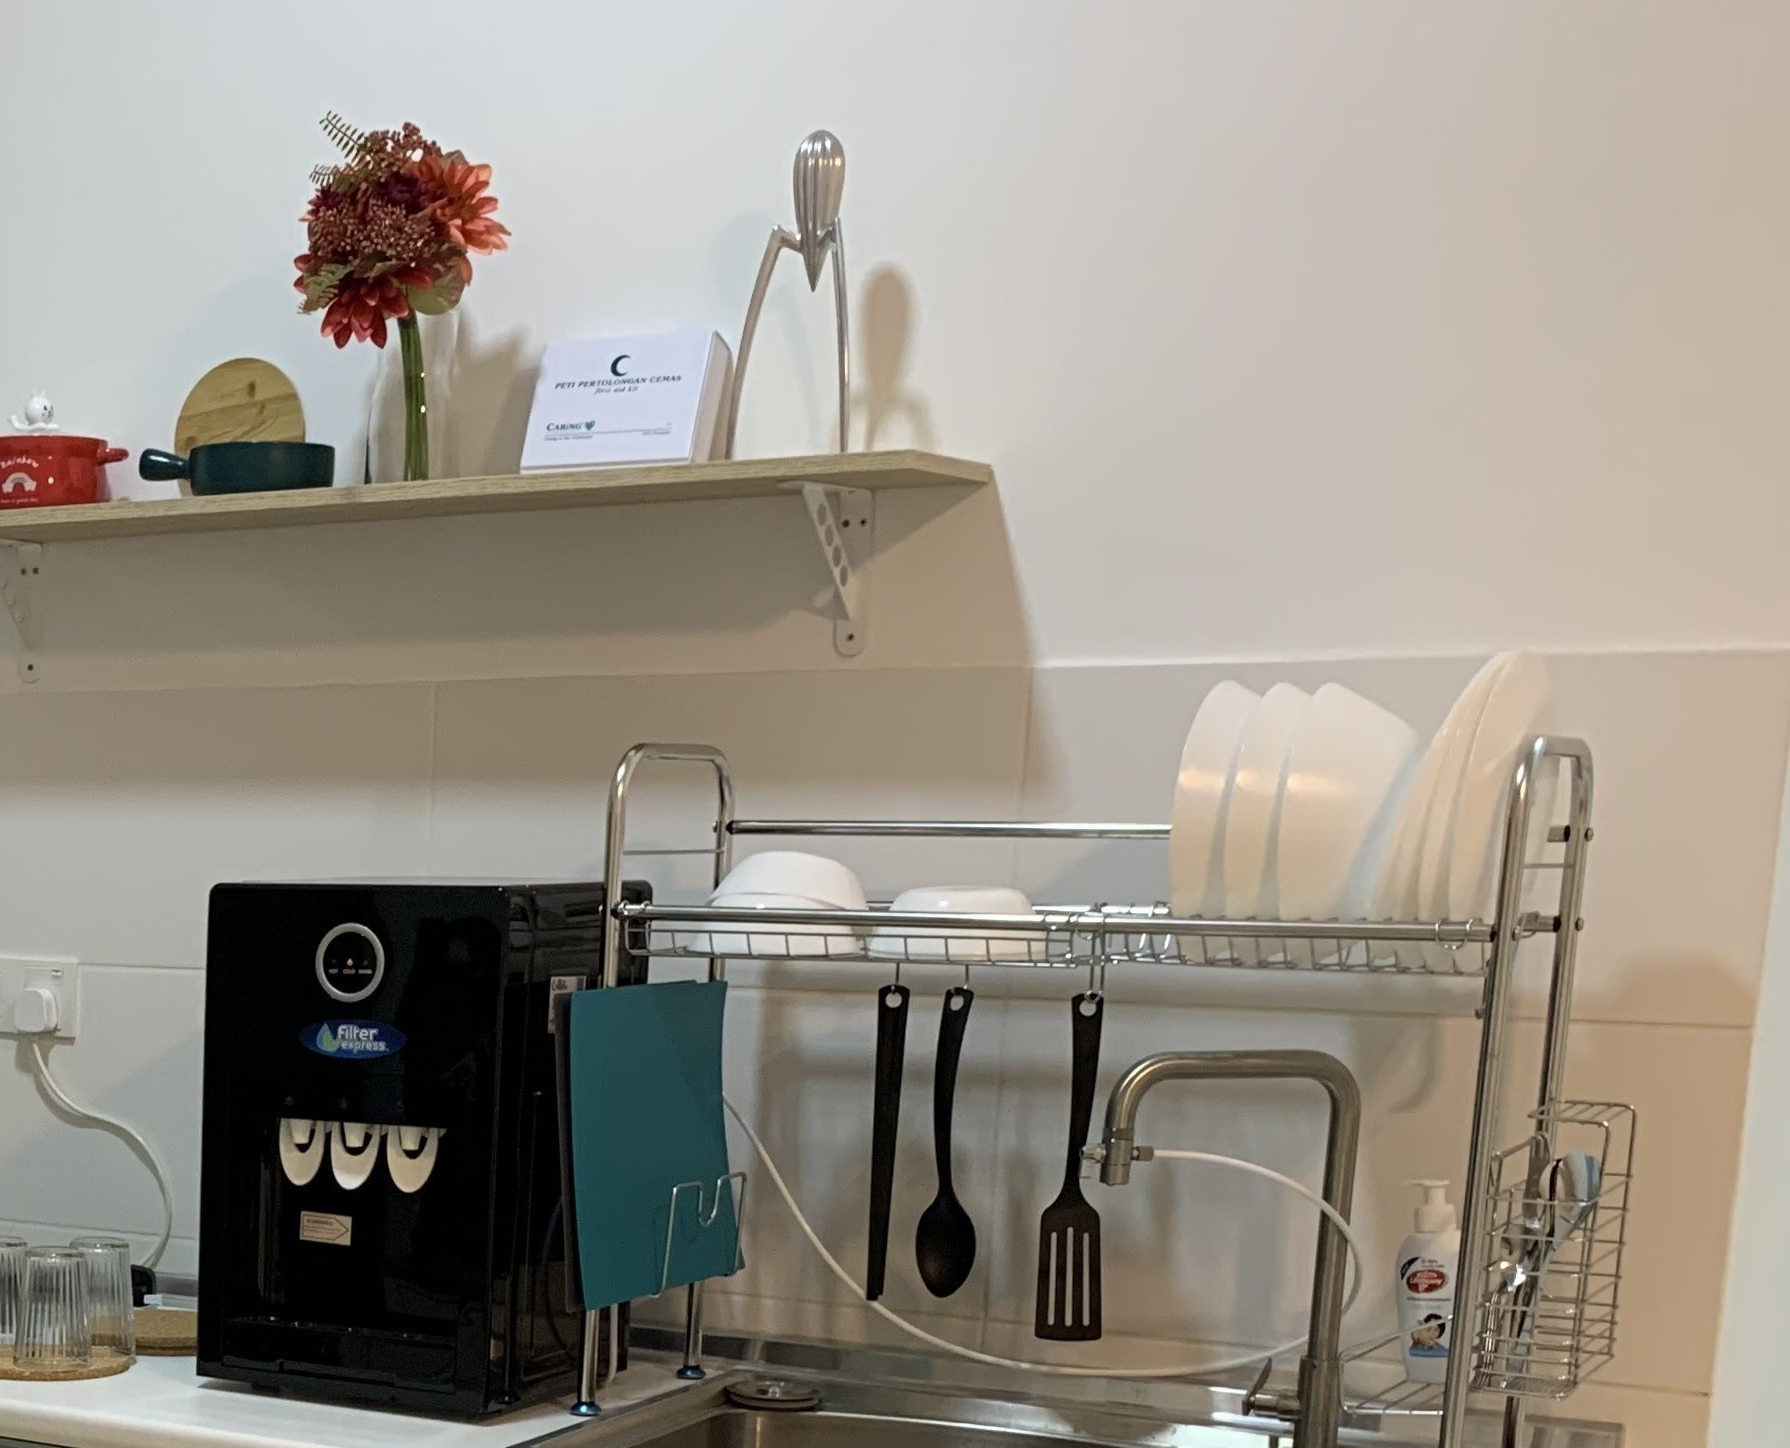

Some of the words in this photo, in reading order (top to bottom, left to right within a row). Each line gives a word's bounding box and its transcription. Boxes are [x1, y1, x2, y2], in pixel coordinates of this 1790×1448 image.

[555, 381, 575, 389] PETI
[578, 377, 647, 388] PERTOLONGAN
[649, 375, 682, 384] CEMAS
[341, 1041, 387, 1054] express
